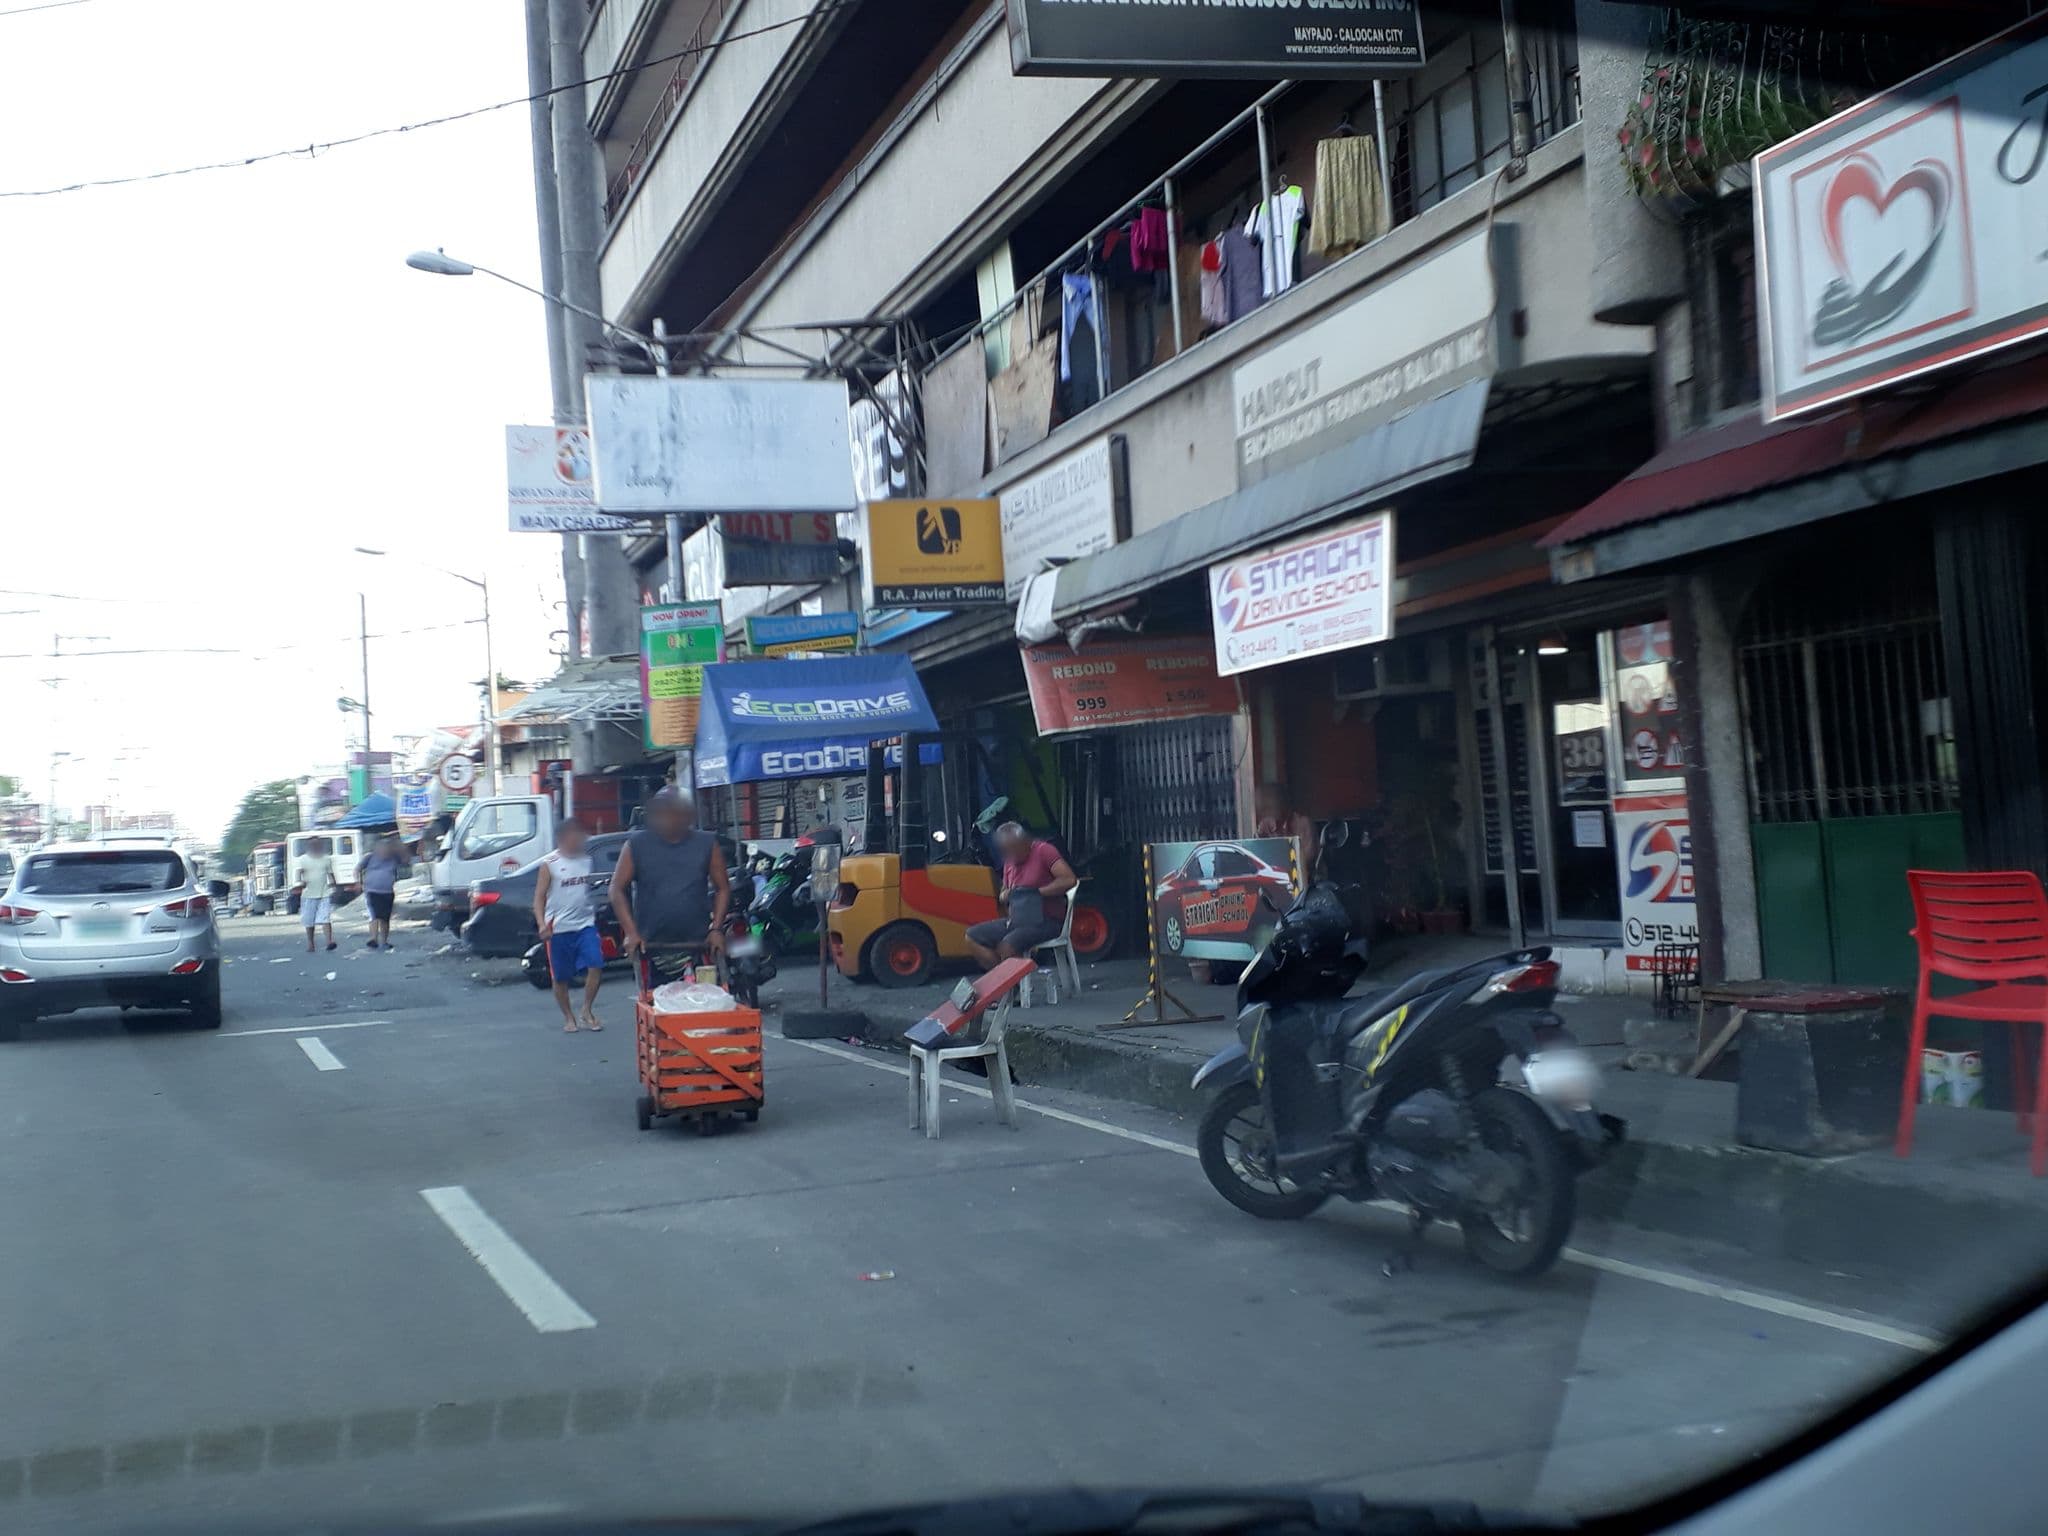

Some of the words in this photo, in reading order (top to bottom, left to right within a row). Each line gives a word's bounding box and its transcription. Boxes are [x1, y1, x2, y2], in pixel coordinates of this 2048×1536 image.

[1294, 27, 1333, 41] MAYPAJO
[1339, 28, 1384, 42] CALOOCAN
[1385, 29, 1403, 43] CITY
[882, 589, 909, 601] R.A.
[912, 588, 953, 600] Javier
[954, 586, 1004, 602] Trading
[1252, 589, 1309, 620] DRIVING
[1313, 570, 1381, 603] SCHOOL
[652, 612, 673, 622] NOW
[1052, 662, 1117, 679] REBOND
[1077, 697, 1107, 711] 999
[1185, 900, 1220, 929] STRAIGHT
[1222, 909, 1249, 924] SCHOOL
